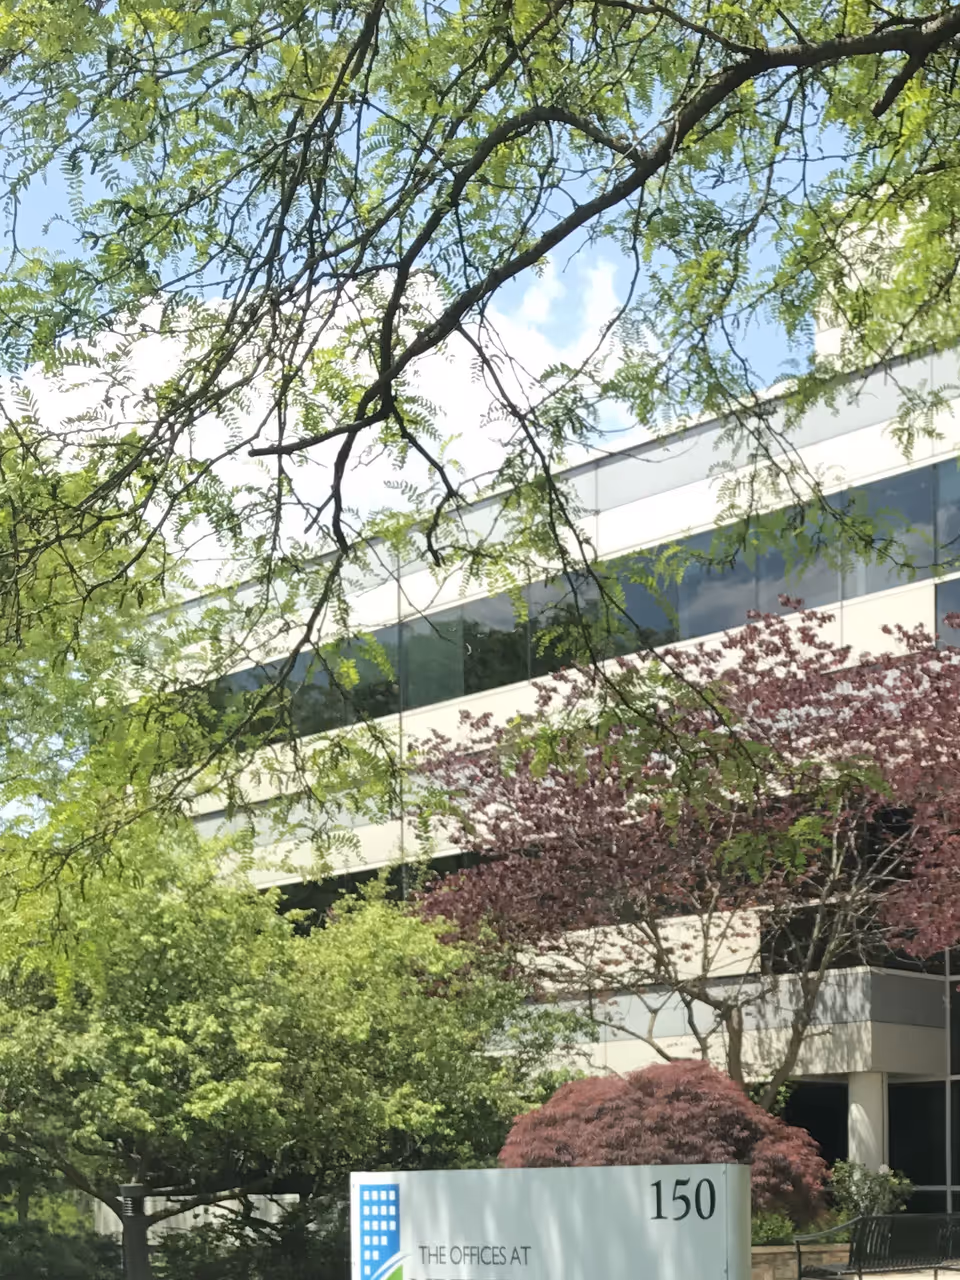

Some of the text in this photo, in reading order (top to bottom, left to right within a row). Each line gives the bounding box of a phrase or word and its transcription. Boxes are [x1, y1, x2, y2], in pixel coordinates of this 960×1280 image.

[650, 1177, 716, 1221] 150
[418, 1245, 532, 1266] THE OFFICES AT
